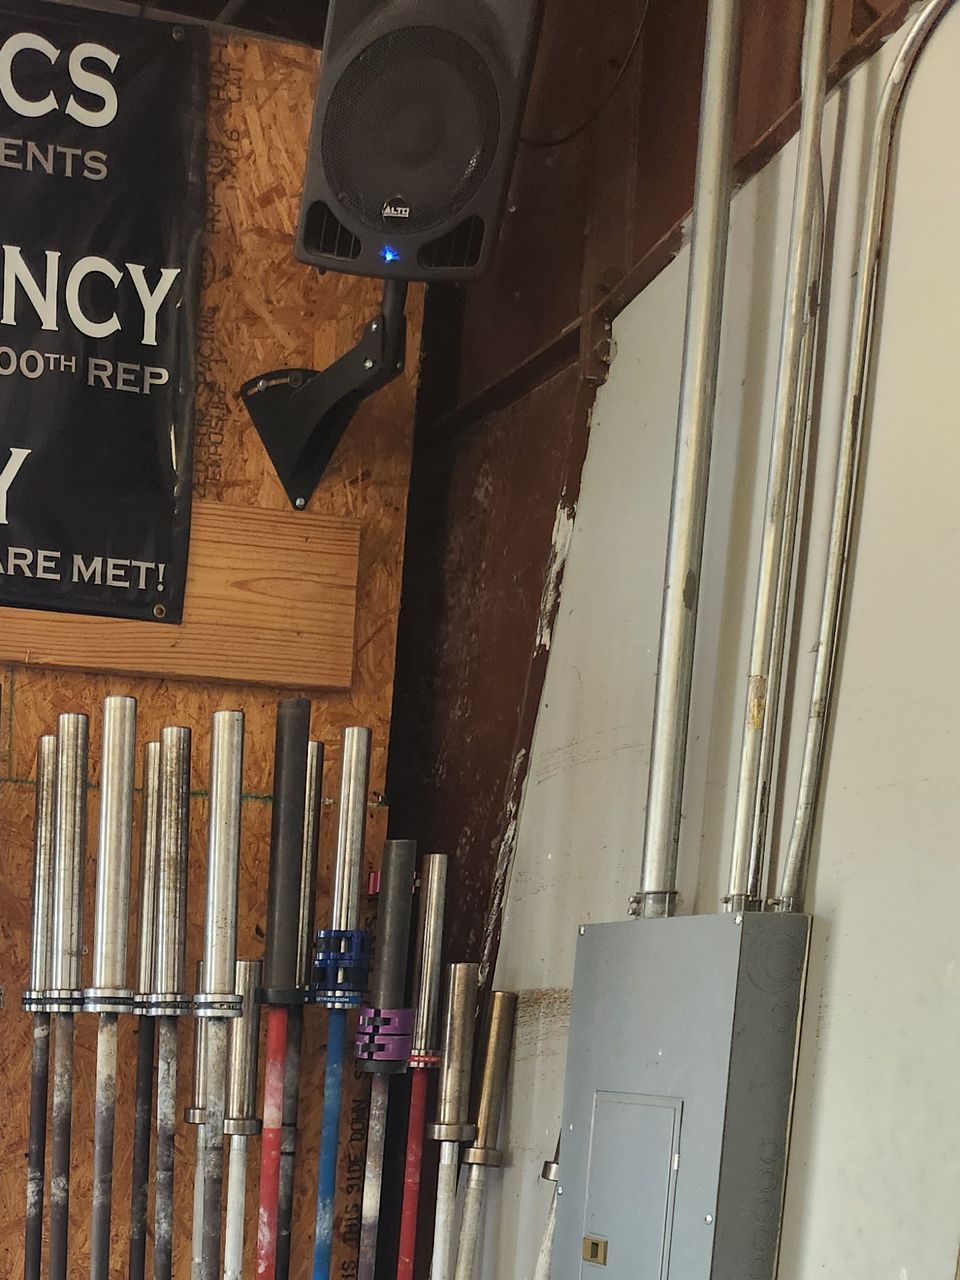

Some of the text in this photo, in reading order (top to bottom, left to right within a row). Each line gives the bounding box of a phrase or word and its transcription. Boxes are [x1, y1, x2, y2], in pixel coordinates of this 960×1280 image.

[384, 205, 410, 217] ALTO
[87, 357, 170, 395] REP
[71, 554, 166, 593] MET!
[350, 1099, 366, 1142] DOWN
